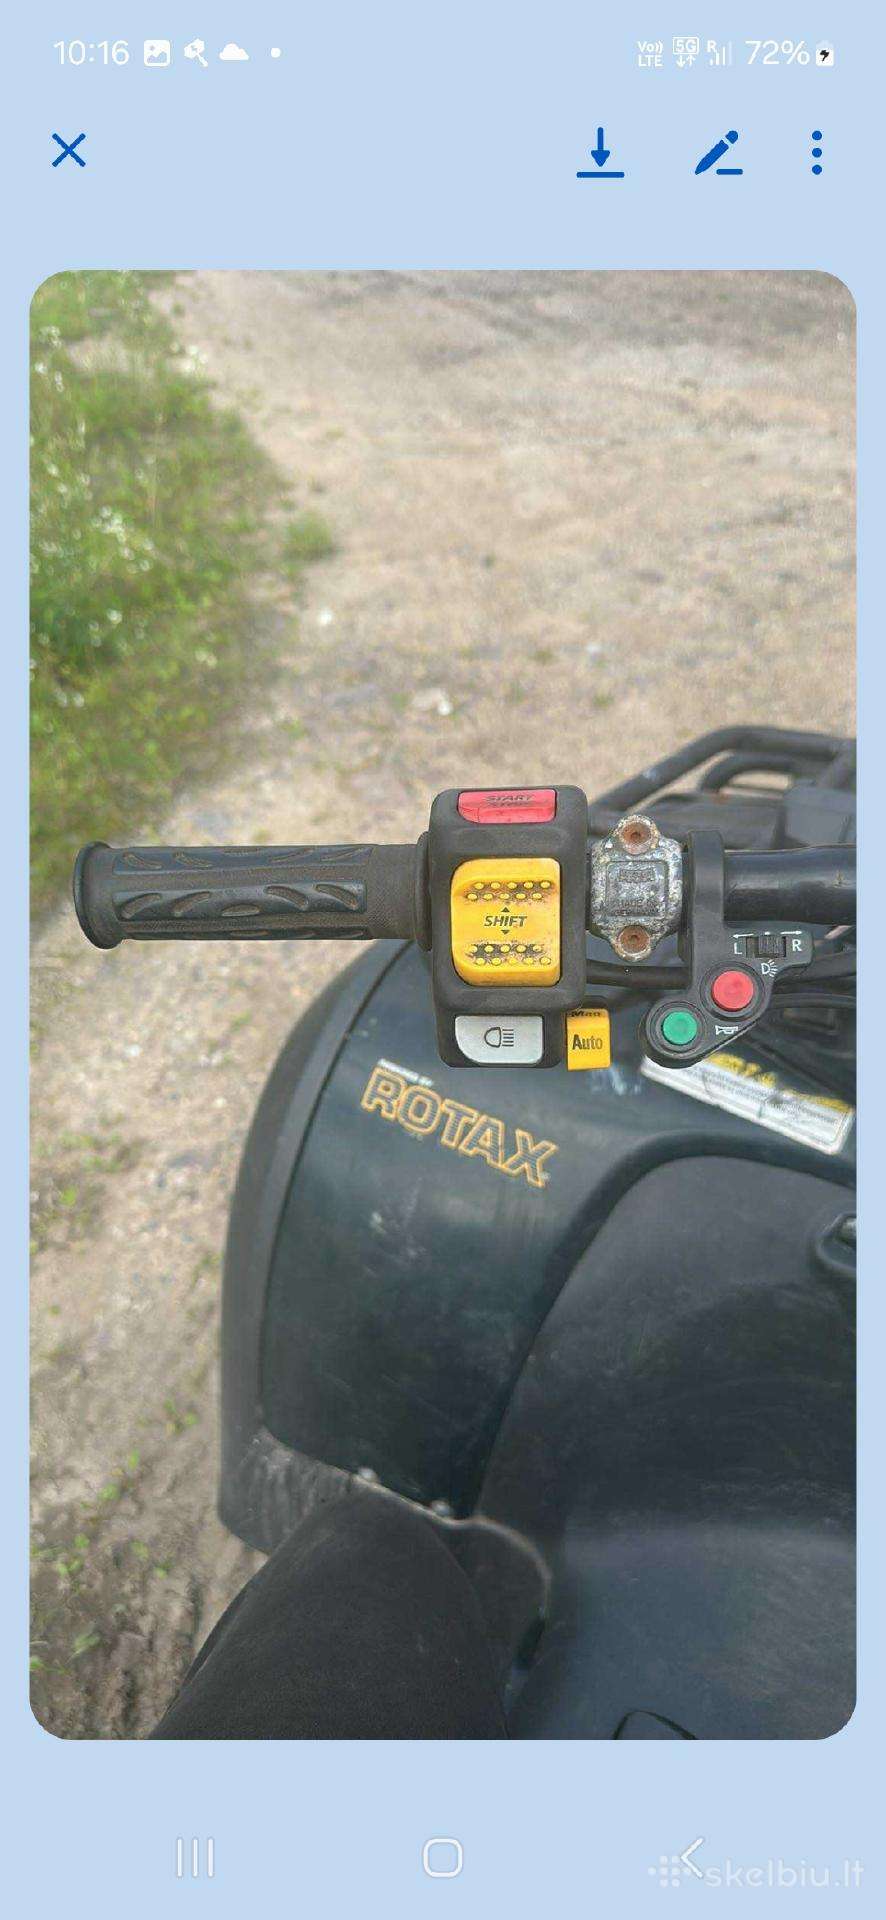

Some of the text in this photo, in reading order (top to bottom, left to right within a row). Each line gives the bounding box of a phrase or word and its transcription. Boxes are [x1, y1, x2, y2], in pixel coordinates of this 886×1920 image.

[676, 39, 697, 52] 5G
[53, 40, 130, 65] 10:16
[745, 40, 810, 65] 72%
[638, 55, 663, 67] LTE
[484, 915, 527, 928] SHIFT
[734, 942, 742, 955] L
[792, 939, 803, 951] R
[572, 1034, 603, 1050] Auto
[361, 1066, 559, 1188] ROTAX
